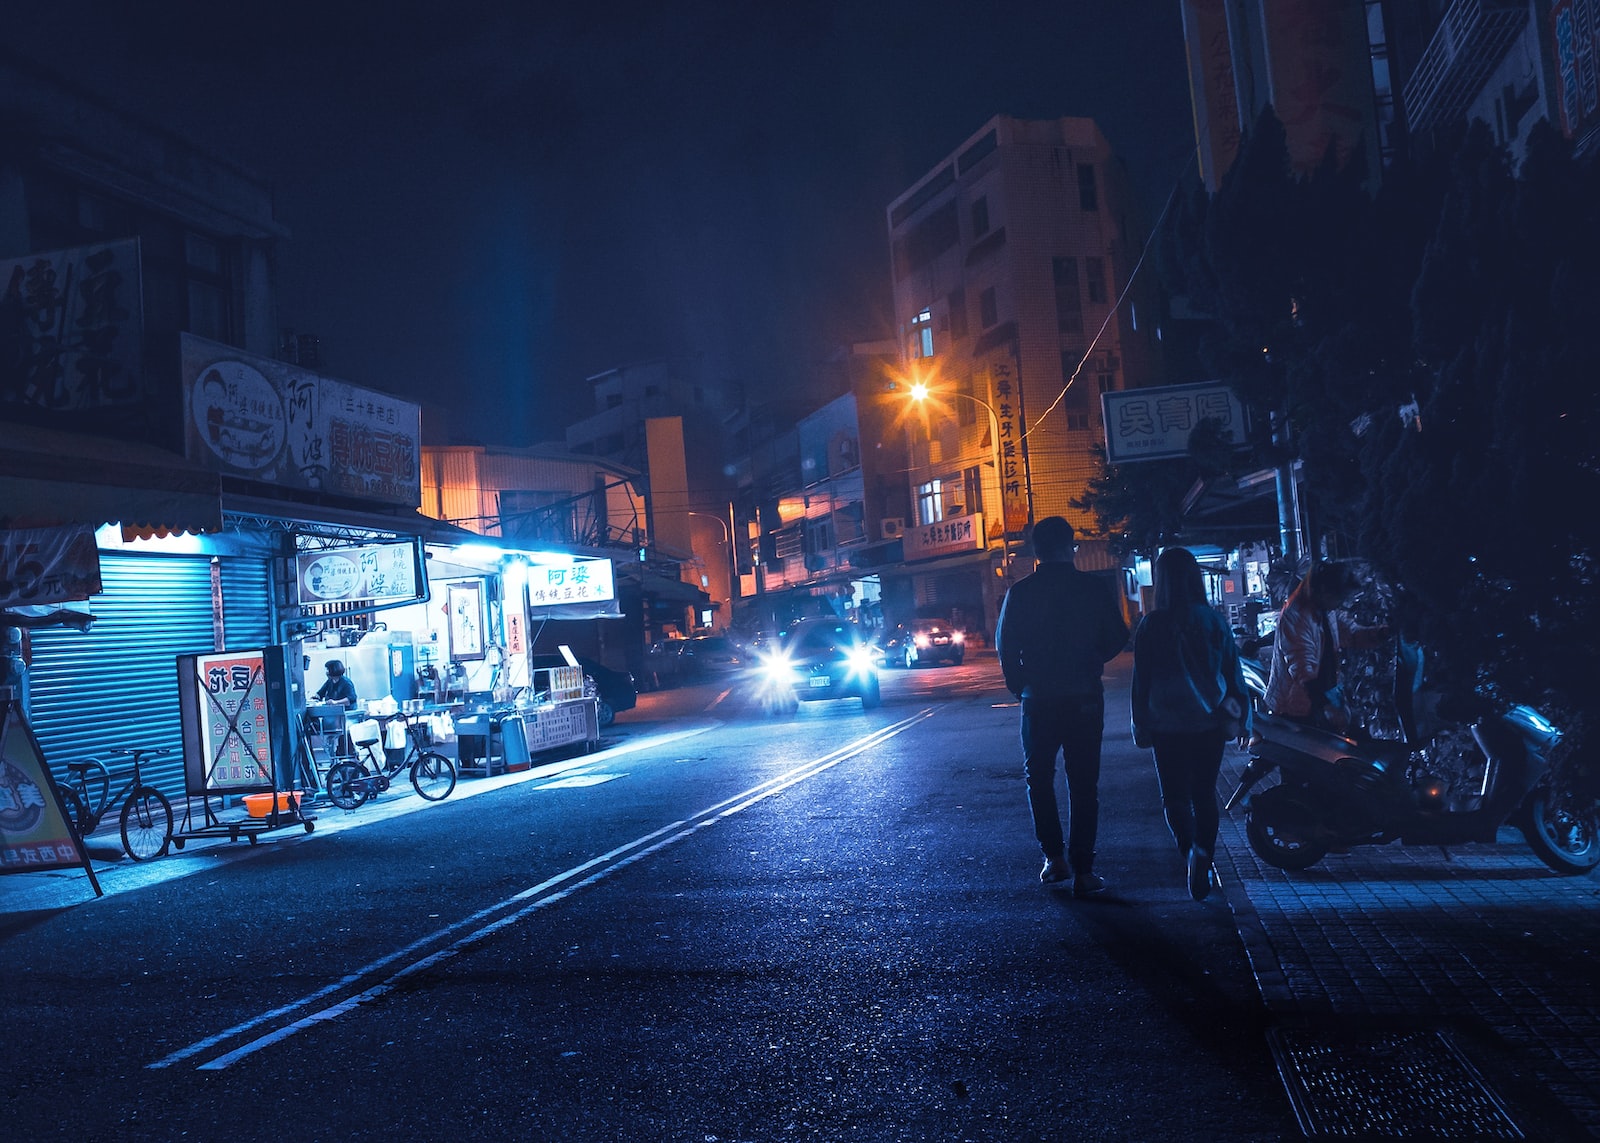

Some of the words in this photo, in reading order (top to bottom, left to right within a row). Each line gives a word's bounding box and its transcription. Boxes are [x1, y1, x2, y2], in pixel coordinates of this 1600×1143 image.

[330, 416, 415, 481] 傳統豆花
[360, 551, 389, 594] 阿婆
[548, 566, 590, 585] 阿婆
